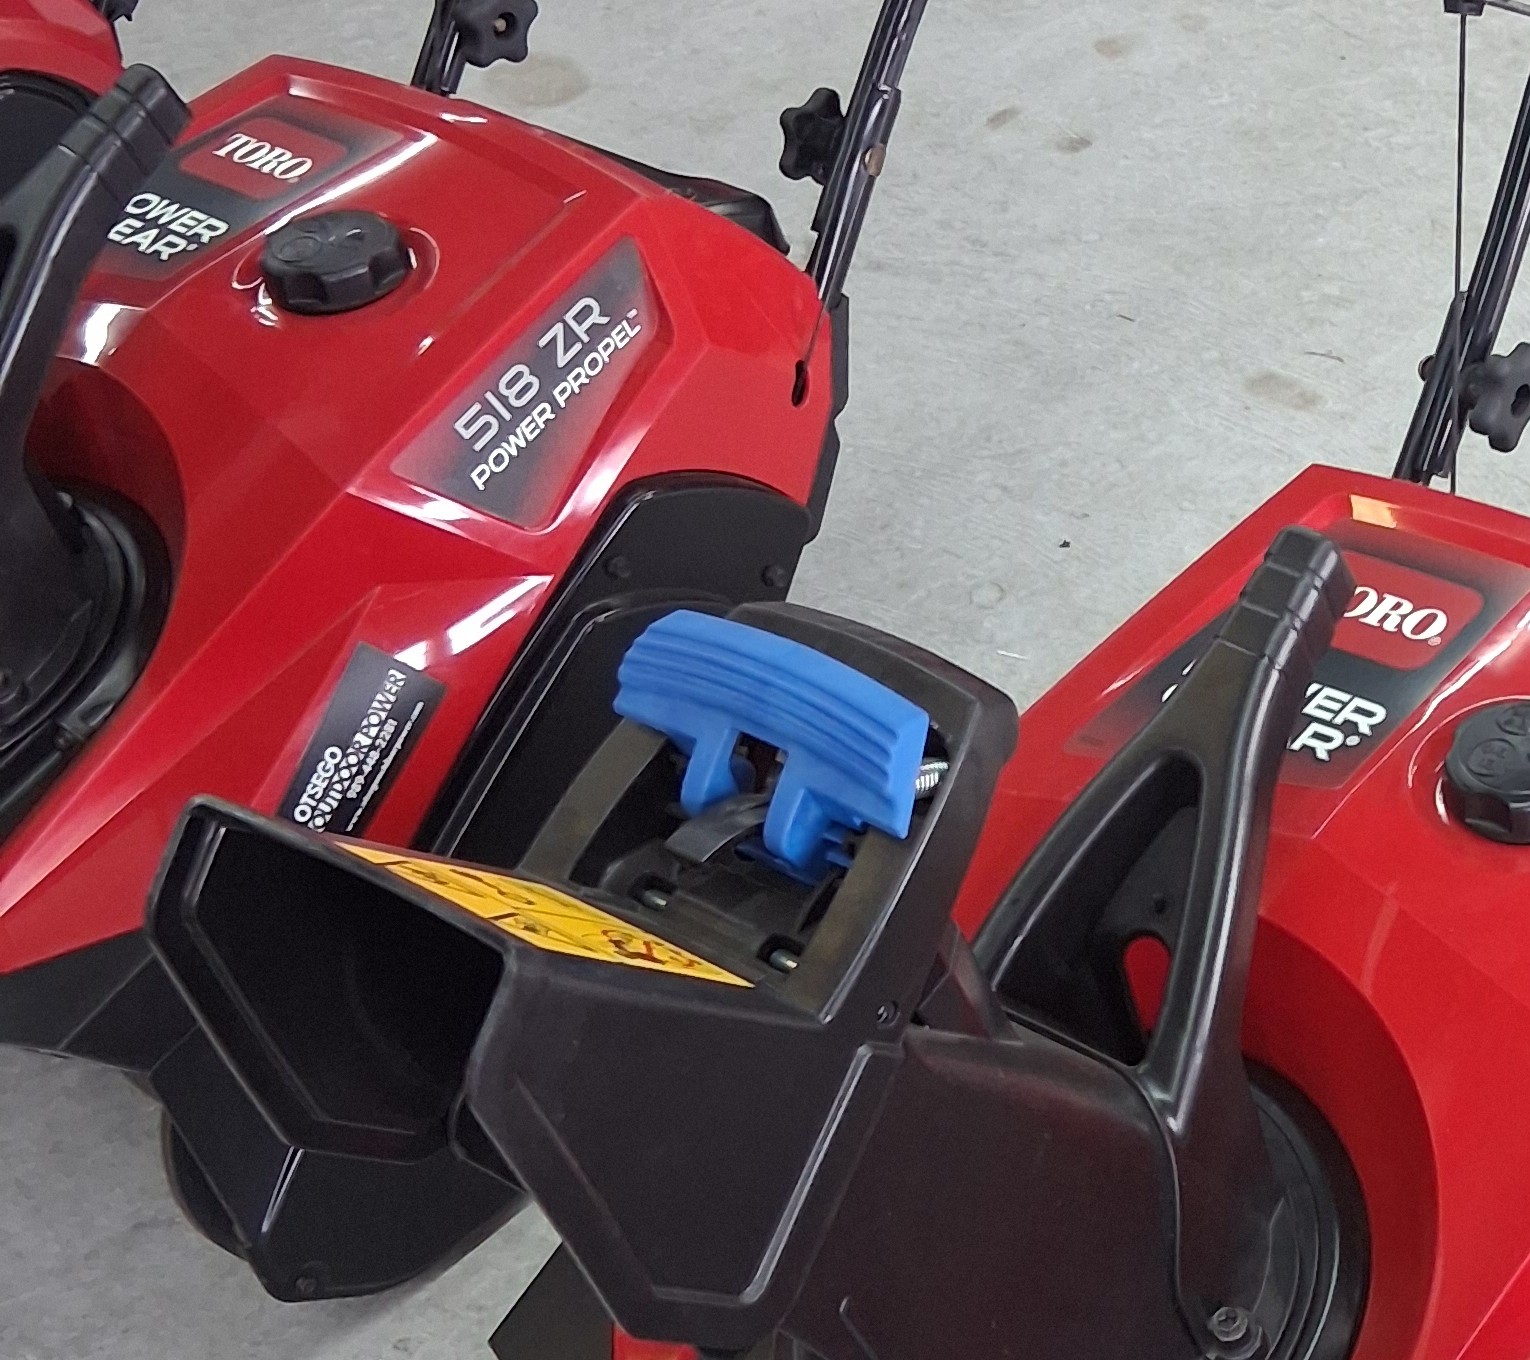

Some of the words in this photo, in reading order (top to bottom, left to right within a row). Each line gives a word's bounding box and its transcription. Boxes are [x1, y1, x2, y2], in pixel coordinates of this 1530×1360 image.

[212, 133, 313, 179] TORO
[107, 217, 190, 261] EAR
[125, 192, 230, 244] OWER
[453, 364, 541, 452] 518
[537, 297, 611, 369] ZR
[470, 402, 556, 491] POWER
[552, 318, 642, 408] PROPEL
[1343, 585, 1448, 641] ORO
[359, 668, 407, 740] POWER
[293, 745, 343, 823] OTSEGO
